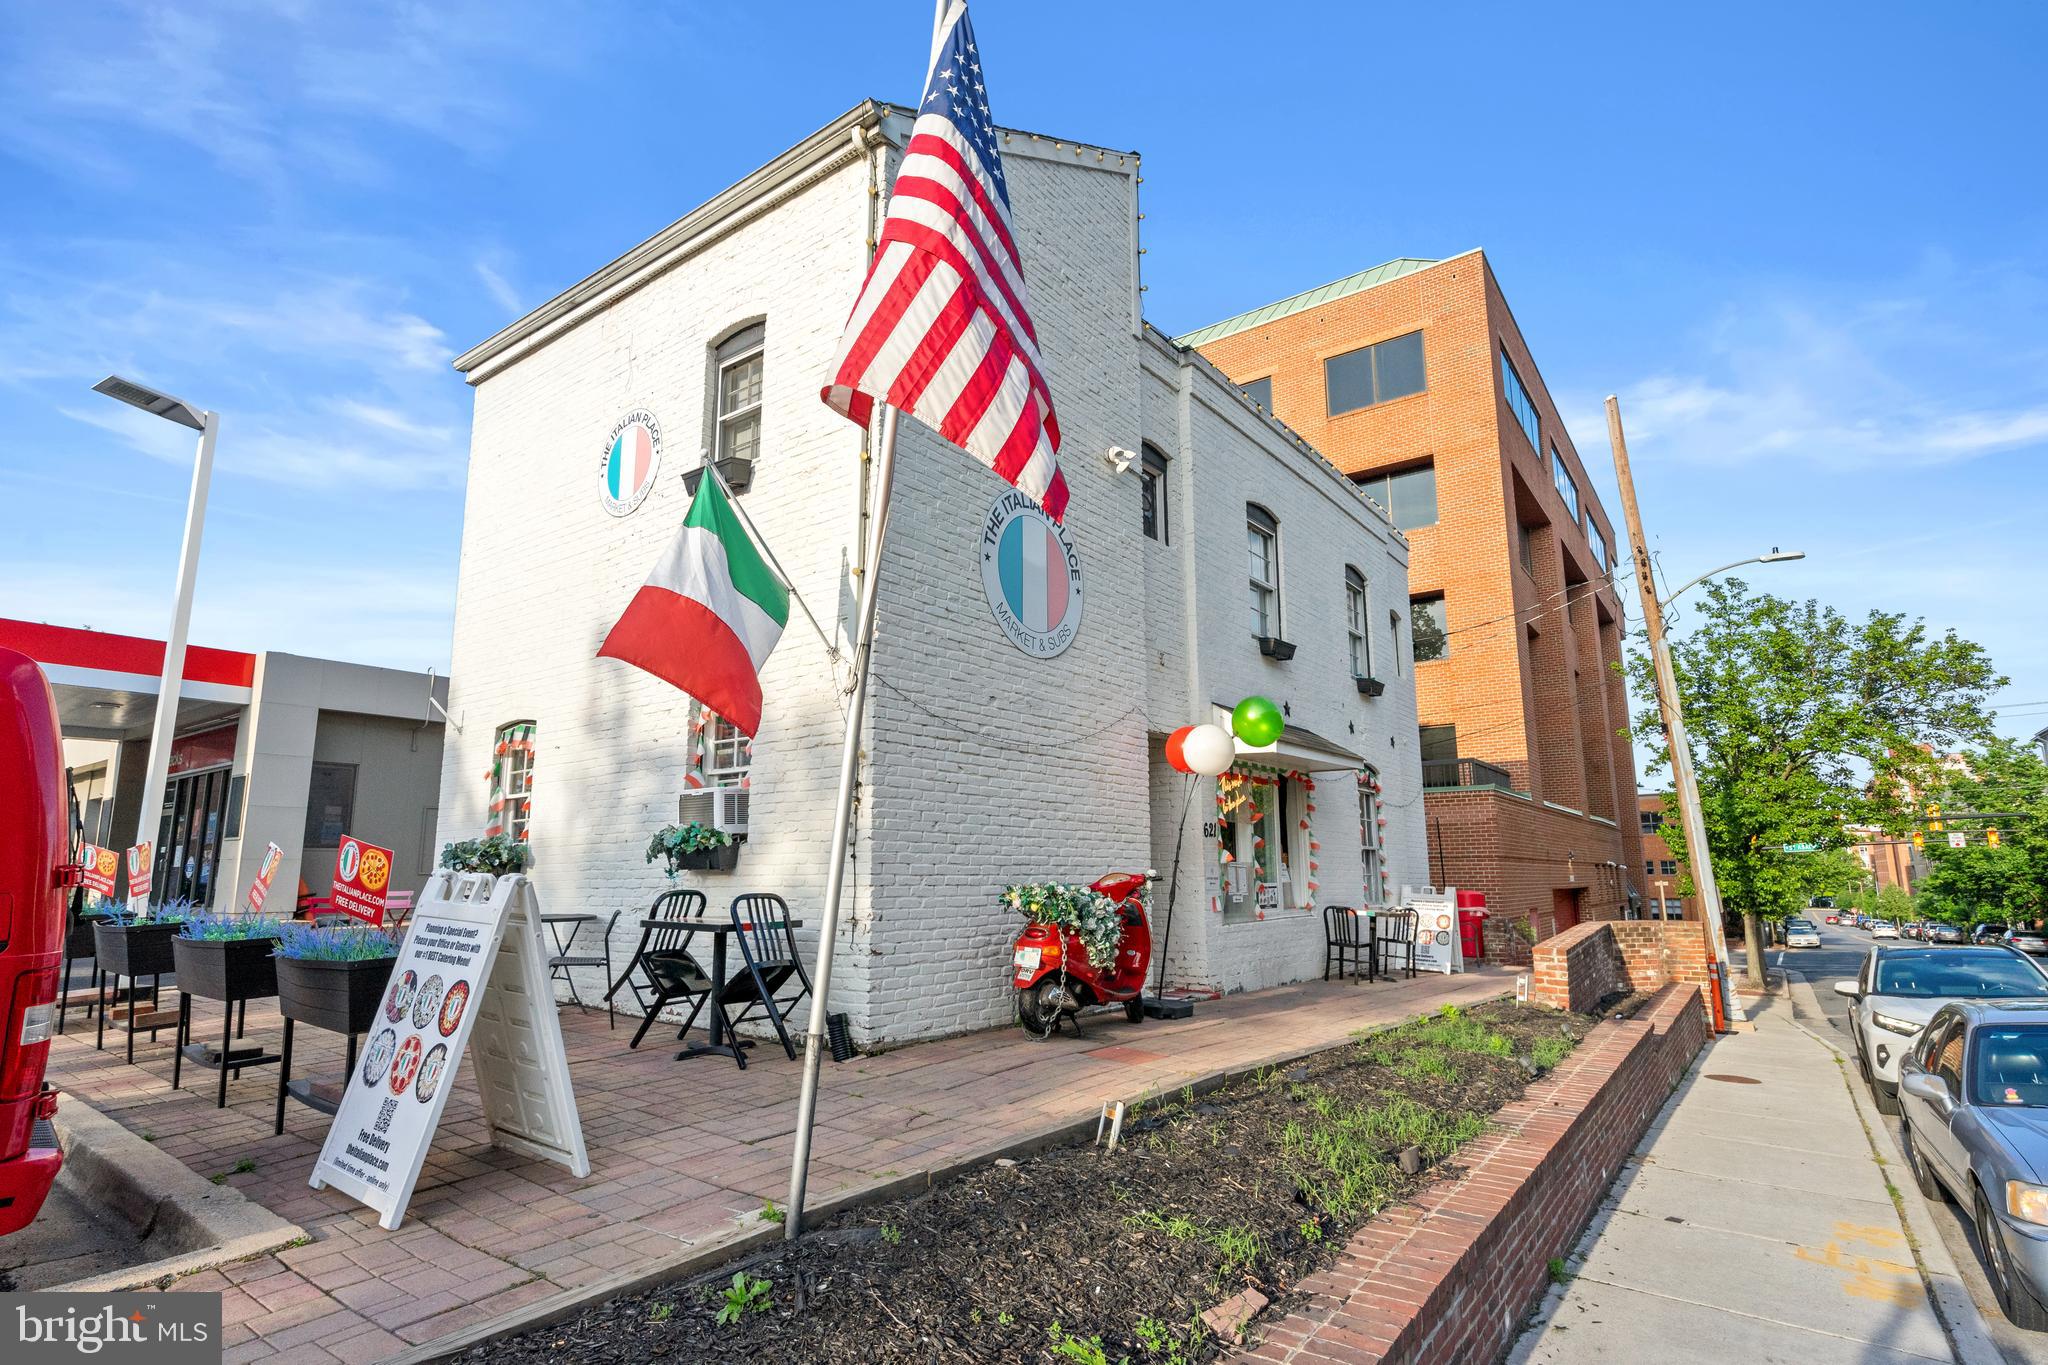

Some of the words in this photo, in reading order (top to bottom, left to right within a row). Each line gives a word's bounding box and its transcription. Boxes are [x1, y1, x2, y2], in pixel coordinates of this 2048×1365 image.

[601, 442, 612, 469] THE
[610, 412, 642, 441] ITALIAN
[641, 413, 660, 448] PLACE
[984, 507, 1005, 546] THE
[996, 601, 1037, 650] MARKET
[1039, 638, 1047, 652] &
[1047, 624, 1072, 651] SUBS
[1203, 822, 1217, 838] 621
[333, 881, 385, 907] THEITALIANPLACE.COM
[335, 895, 349, 908] FREE
[348, 900, 376, 918] DELIVERY
[425, 923, 444, 936] Planning
[446, 926, 464, 937] Special
[462, 927, 479, 939] Event?
[413, 935, 428, 944] Please
[427, 937, 438, 947] your
[437, 938, 450, 949] Office
[449, 941, 456, 950] or
[455, 941, 471, 952] Guests
[470, 943, 481, 954] with
[414, 950, 422, 958] our
[427, 951, 439, 961] BEST
[437, 952, 457, 966] Catering
[358, 1128, 371, 1144] Free
[368, 1133, 391, 1154] Delivery
[346, 1143, 389, 1172] theitalianplace.com
[346, 1163, 356, 1174] time
